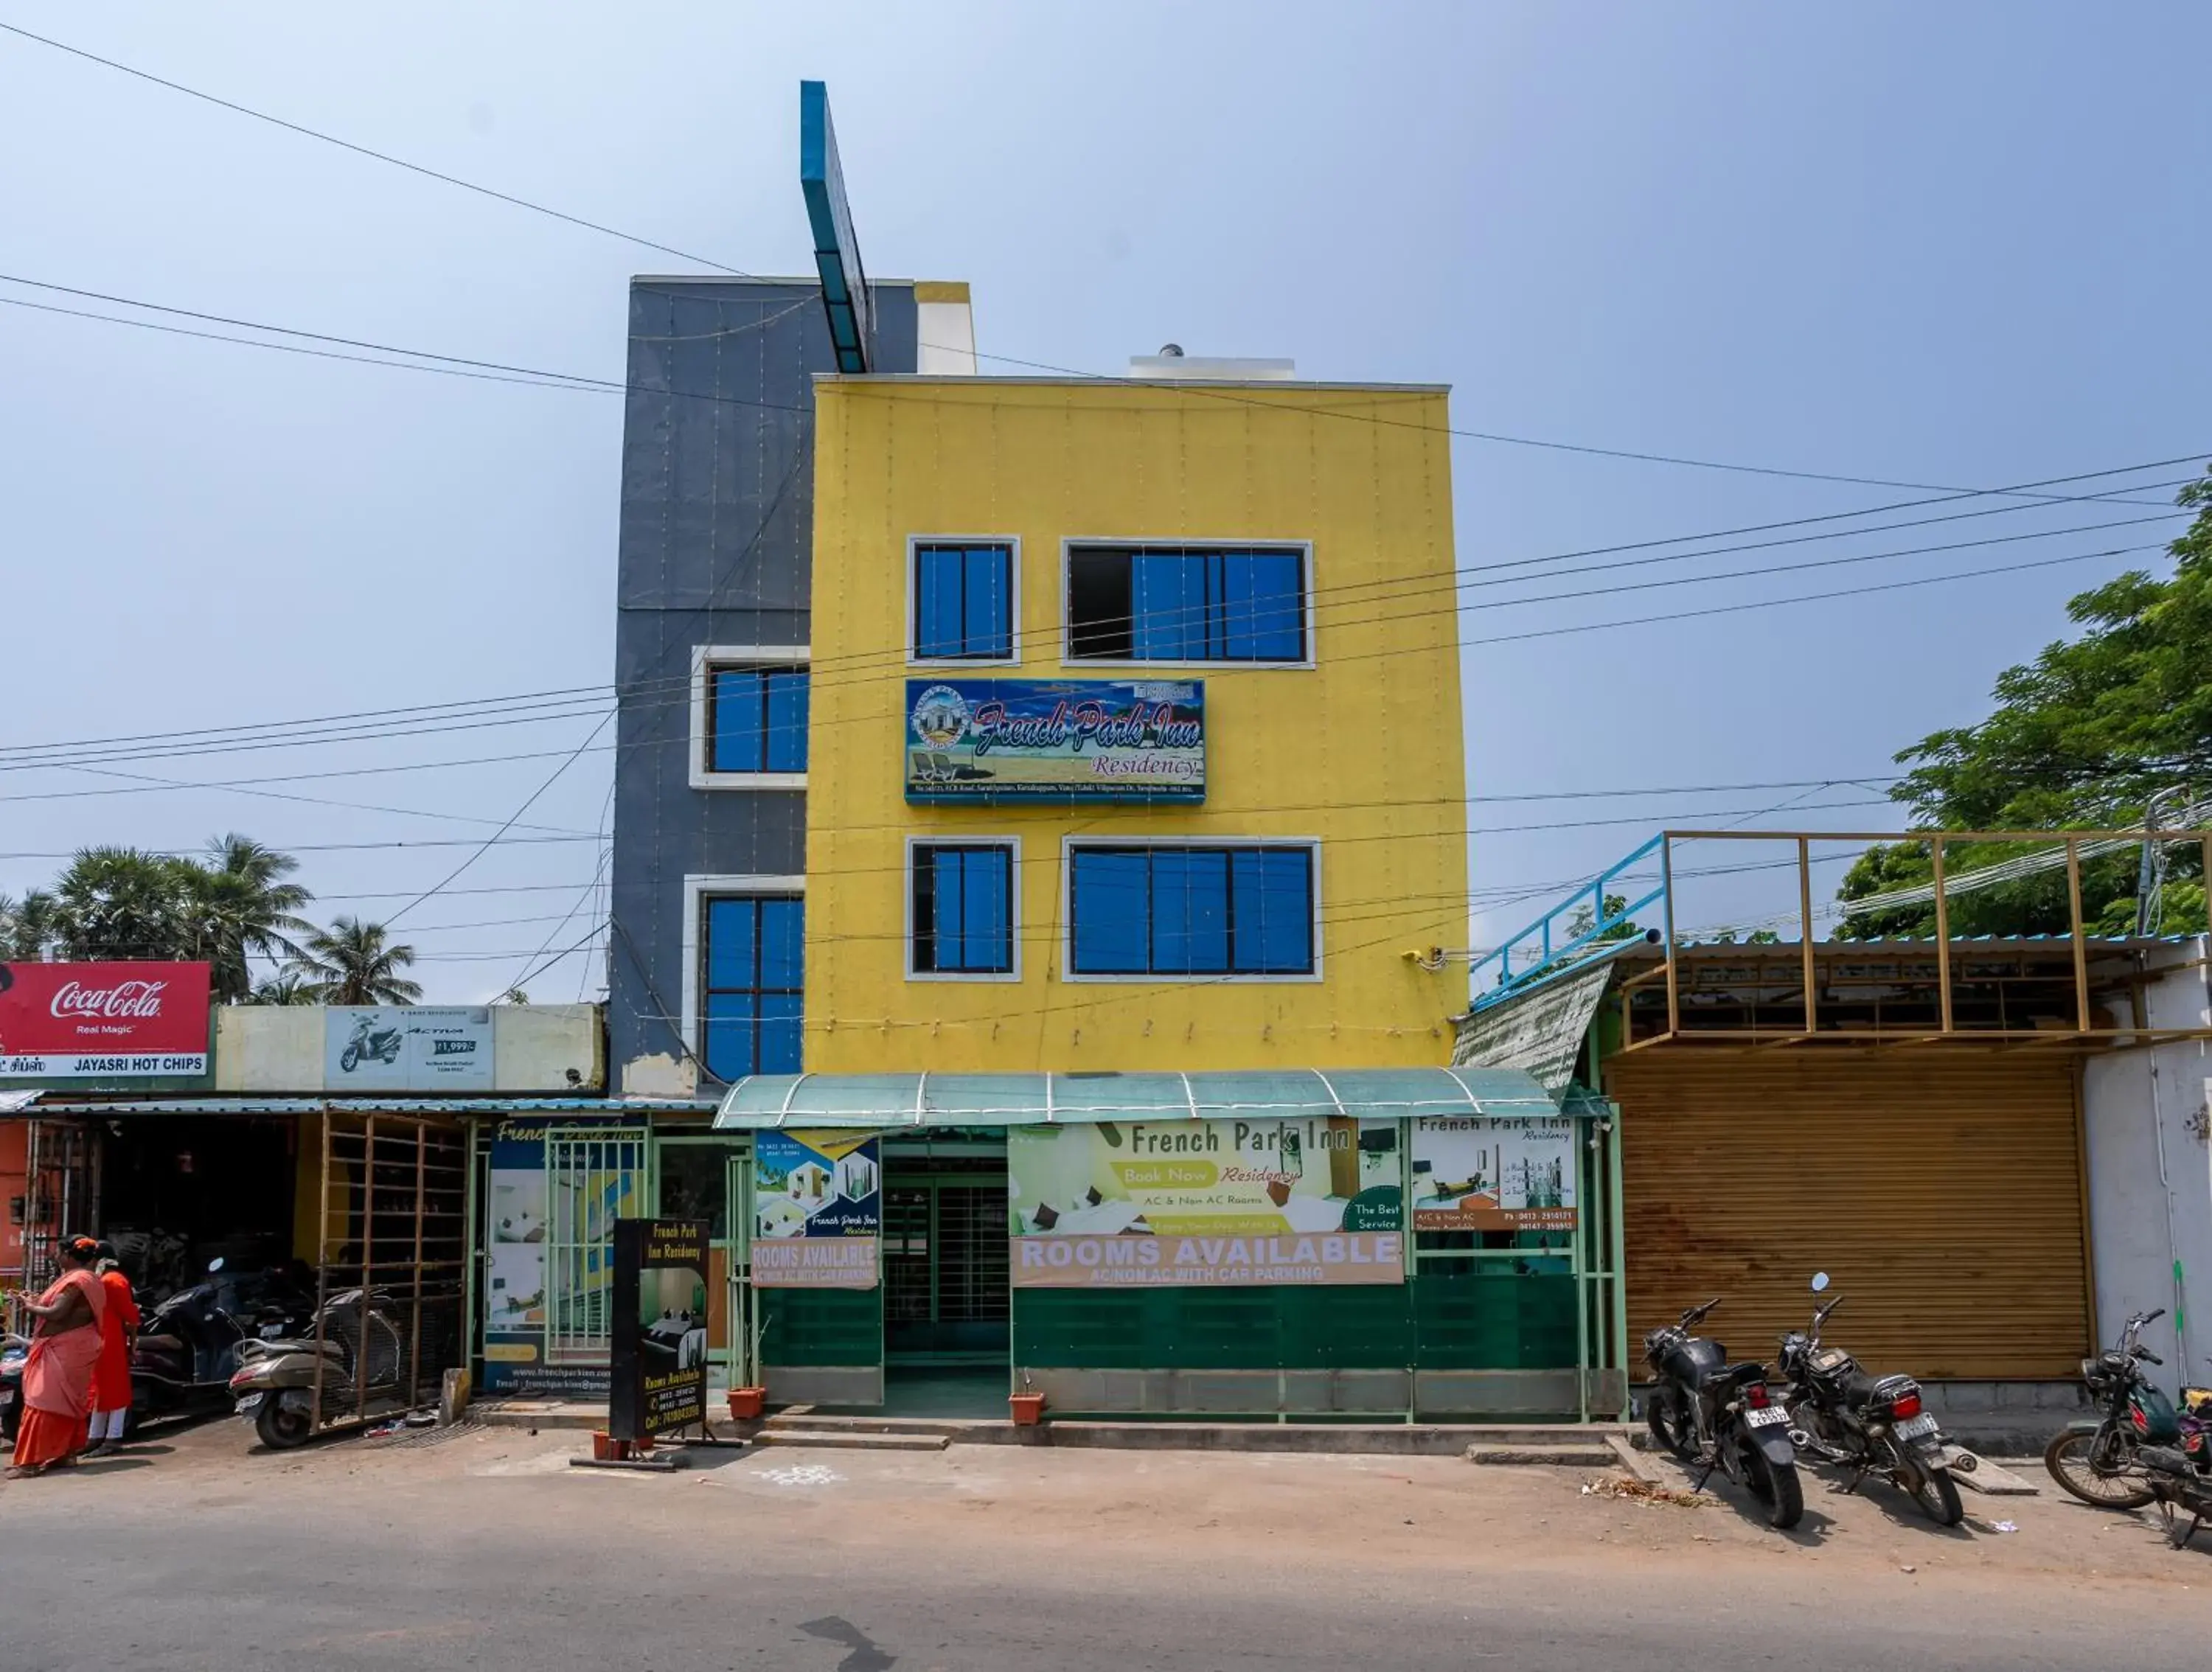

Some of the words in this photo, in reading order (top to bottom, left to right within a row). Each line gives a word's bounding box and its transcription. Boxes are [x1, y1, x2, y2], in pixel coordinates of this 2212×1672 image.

[975, 700, 1066, 756] French
[1073, 700, 1145, 751] Park
[1152, 701, 1200, 747] Inn
[1091, 753, 1197, 780] Residency
[50, 981, 170, 1018] Coca-Cola
[76, 1025, 100, 1034] Real
[101, 1025, 133, 1036] Magic
[74, 1058, 128, 1071] JAYASRI
[132, 1058, 158, 1070] HOT
[163, 1057, 203, 1070] CHIPS
[1419, 1116, 1480, 1132] French
[1490, 1116, 1531, 1130] Park
[1132, 1121, 1219, 1154] French
[1234, 1121, 1293, 1152] Park
[1307, 1120, 1351, 1150] Inn
[1124, 1167, 1162, 1183] Book
[1169, 1167, 1207, 1182] Now
[1221, 1166, 1301, 1185] Residency
[1144, 1197, 1163, 1205] AC
[1206, 1195, 1224, 1205] AC
[1227, 1194, 1263, 1205] Rooms
[1354, 1204, 1375, 1215] The
[1378, 1203, 1399, 1215] Best
[1358, 1218, 1397, 1230] Service
[753, 1246, 799, 1269] ROOMS
[803, 1244, 875, 1267] AVAILABLE
[1021, 1238, 1162, 1267] ROOMS
[1175, 1236, 1398, 1266] AVAILABLE
[1176, 1267, 1214, 1282] WITH
[1219, 1267, 1250, 1281] CAR
[1255, 1267, 1324, 1281] PARKING
